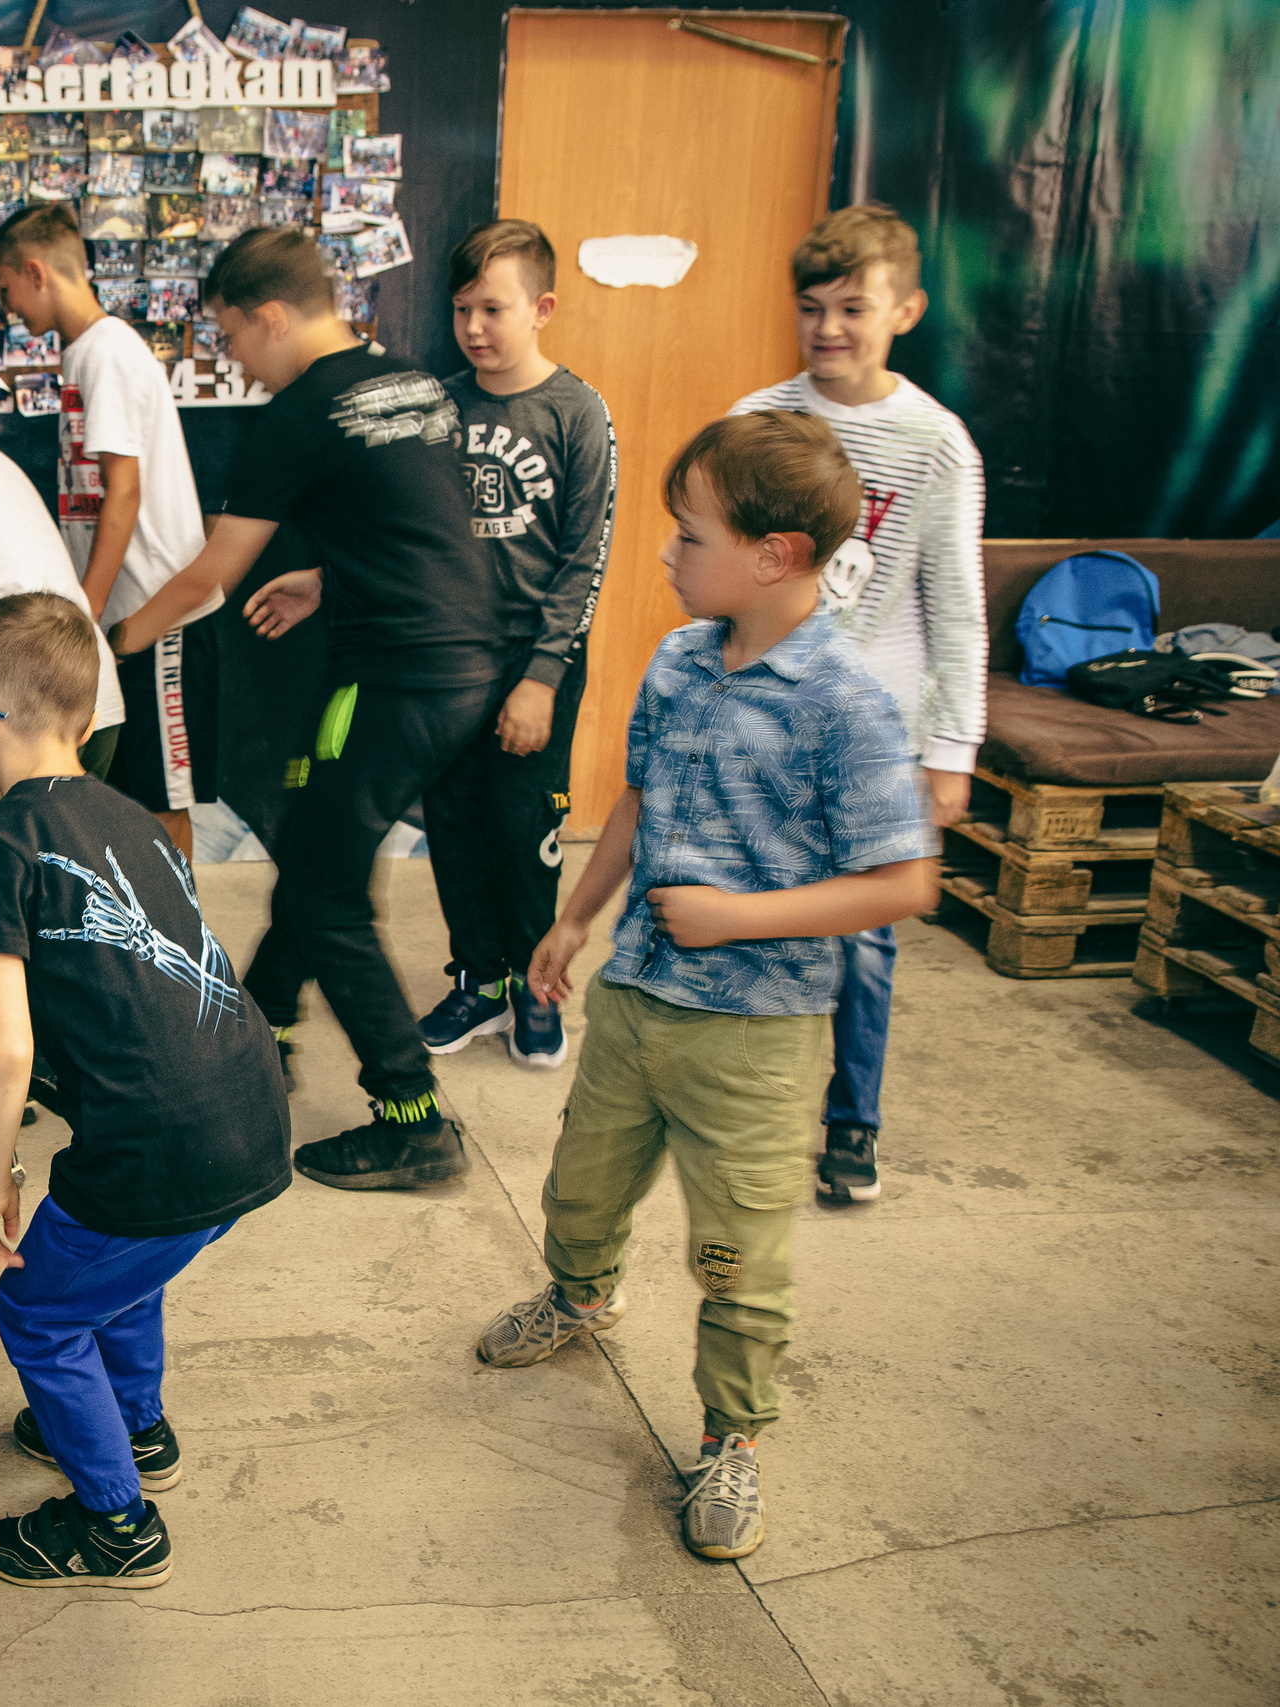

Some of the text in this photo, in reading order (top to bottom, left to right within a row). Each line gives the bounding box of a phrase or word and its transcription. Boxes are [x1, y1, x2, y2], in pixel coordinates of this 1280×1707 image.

[455, 423, 555, 501] ERIOR
[473, 521, 513, 535] TAGE
[163, 666, 183, 717] NEED
[167, 723, 191, 771] LUCK
[703, 1260, 730, 1274] ARMY
